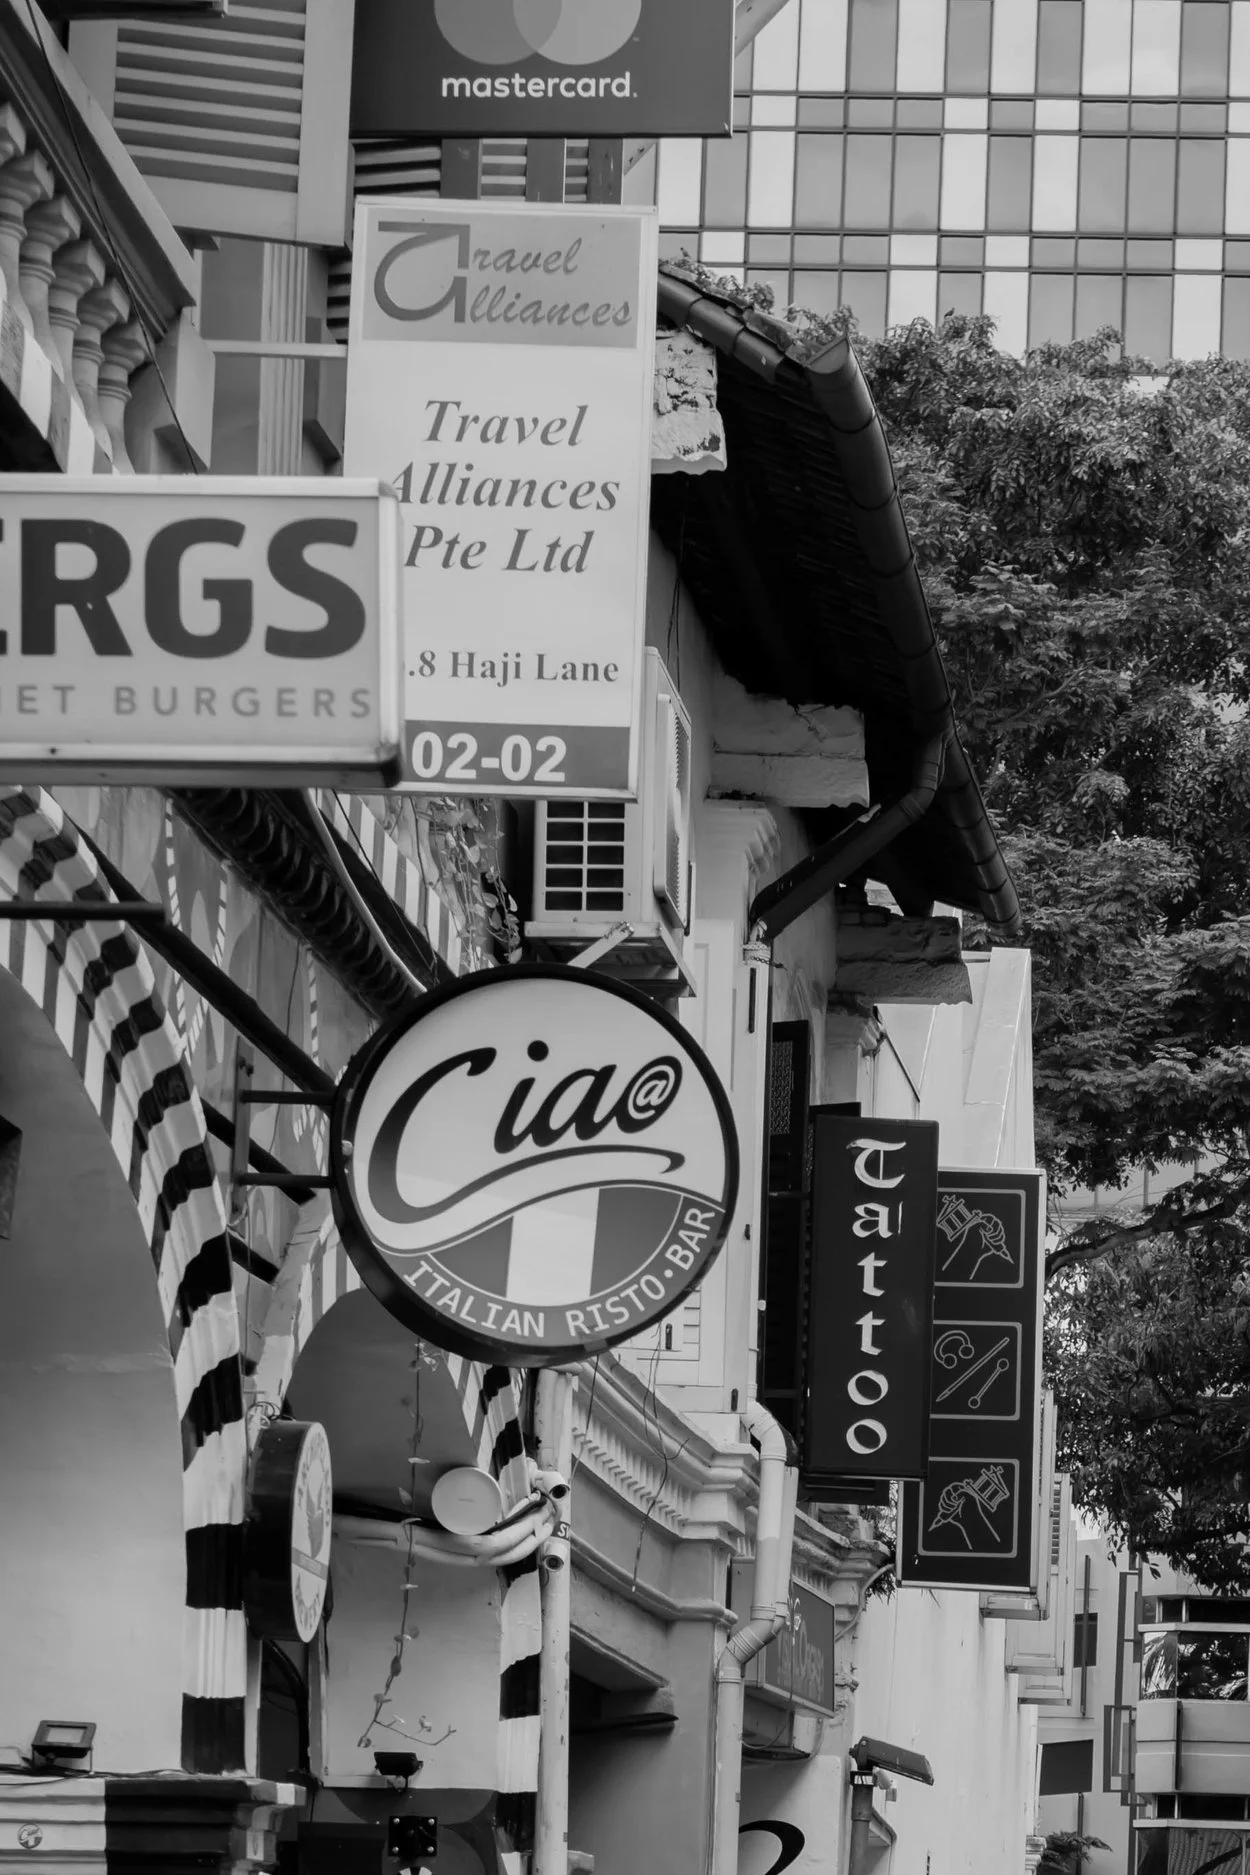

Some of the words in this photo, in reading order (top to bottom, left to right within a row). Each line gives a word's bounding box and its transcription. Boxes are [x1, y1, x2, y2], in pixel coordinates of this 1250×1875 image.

[441, 71, 631, 98] mastercard
[423, 400, 589, 447] Travel
[392, 461, 621, 511] Alliances
[404, 524, 488, 570] Pte
[502, 528, 596, 574] Ltd
[0, 517, 366, 659] RGS
[450, 651, 522, 688] Haji
[536, 652, 620, 682] Lane
[114, 686, 371, 718] BURGERS
[411, 731, 568, 782] 02-02
[403, 1260, 545, 1338] ITALIAN
[846, 1138, 907, 1455] Tattoo
